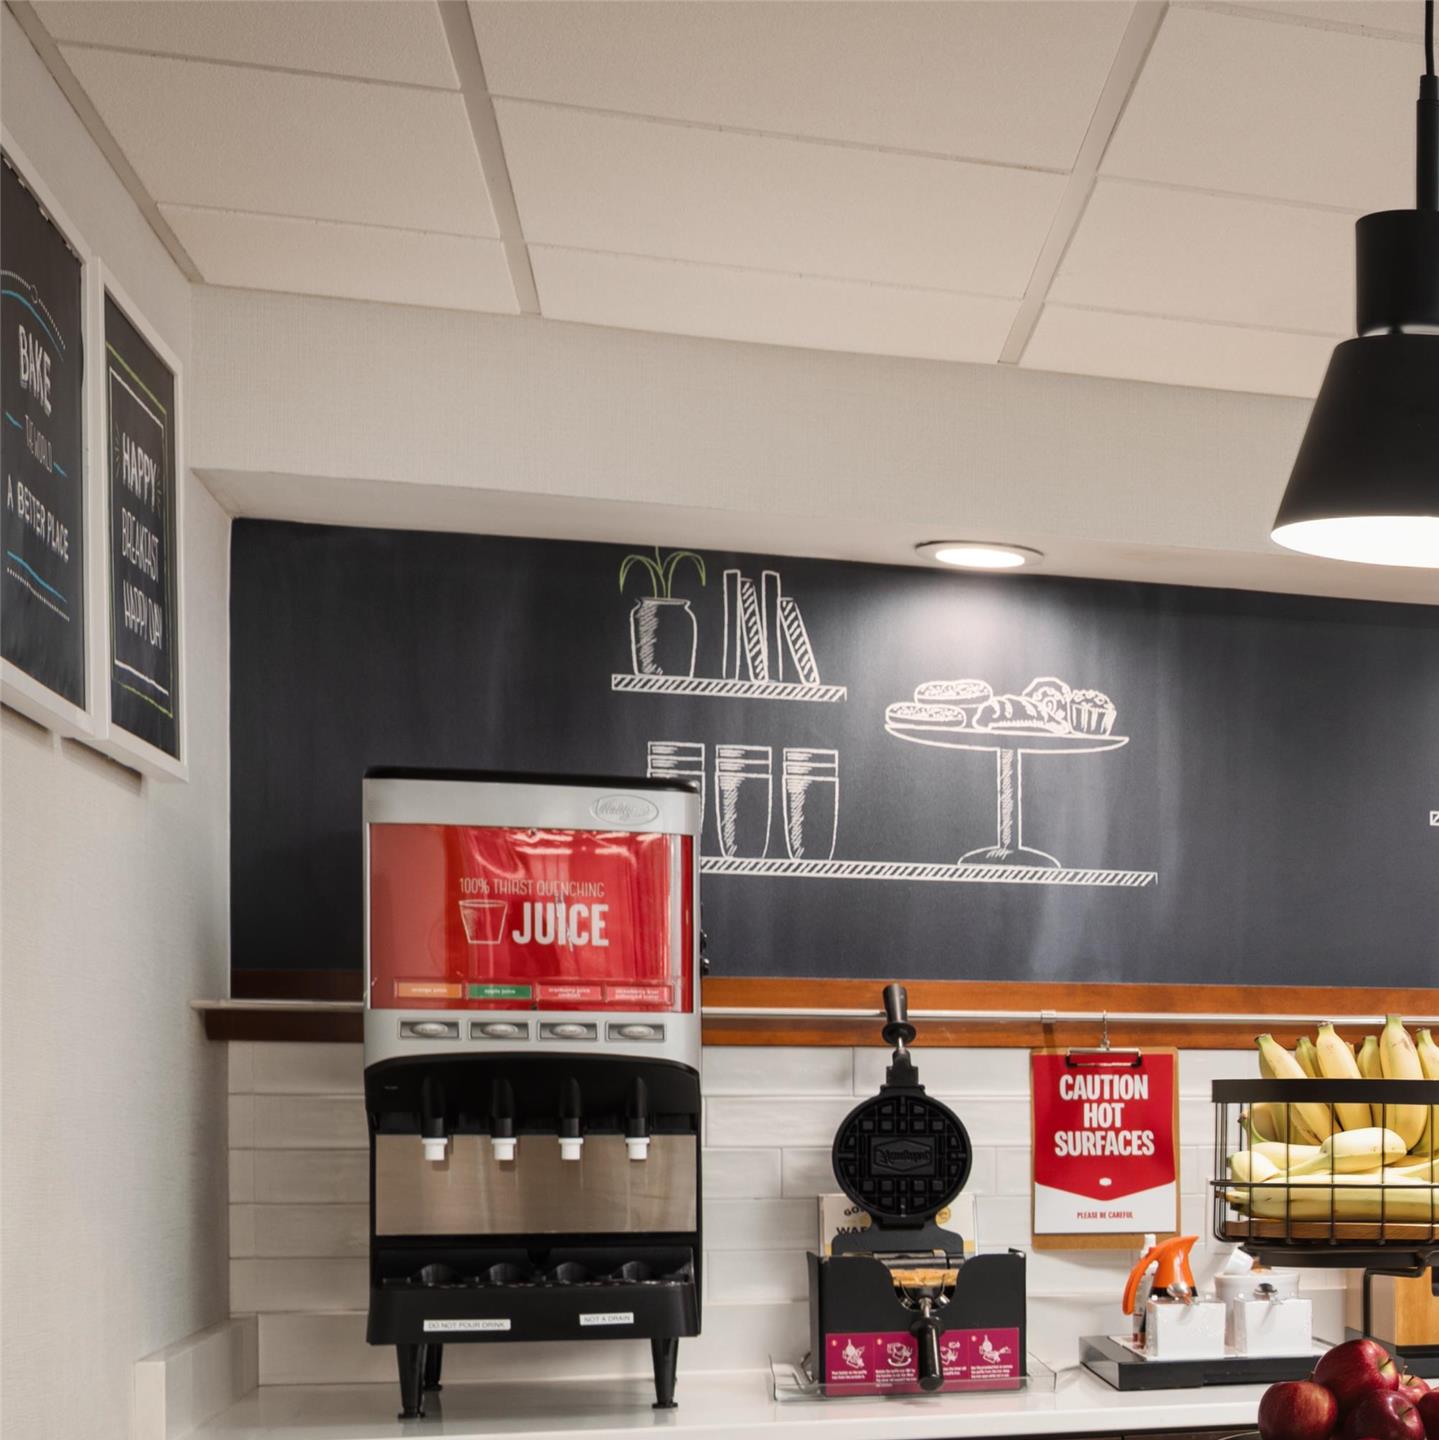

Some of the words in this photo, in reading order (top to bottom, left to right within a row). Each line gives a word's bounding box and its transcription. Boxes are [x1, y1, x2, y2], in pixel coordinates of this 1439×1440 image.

[18, 323, 52, 416] BAKE
[122, 432, 158, 511] HAPPY
[7, 474, 14, 511] A
[17, 481, 46, 541] BETTER
[46, 511, 69, 564] PLACE
[122, 507, 160, 582] BREAKFAST
[123, 579, 148, 638] HAPPY
[148, 597, 163, 650] DAY
[459, 877, 490, 894] 100%
[493, 879, 534, 895] THIRST
[536, 880, 605, 898] QUENCHING
[512, 902, 610, 947] JUICE
[1058, 1074, 1149, 1101] CAUTION
[1083, 1102, 1125, 1128] HOT
[1054, 1130, 1155, 1157] SURFACES
[1077, 1211, 1098, 1219] PLEASE
[1099, 1211, 1106, 1219] BE
[1108, 1211, 1133, 1219] CAREFUL
[428, 1321, 439, 1329] DO
[441, 1321, 457, 1329] NOT
[458, 1321, 480, 1329] POUR
[481, 1321, 505, 1329] DRINK
[584, 1315, 600, 1323] NOT
[608, 1314, 631, 1322] DRAIN
